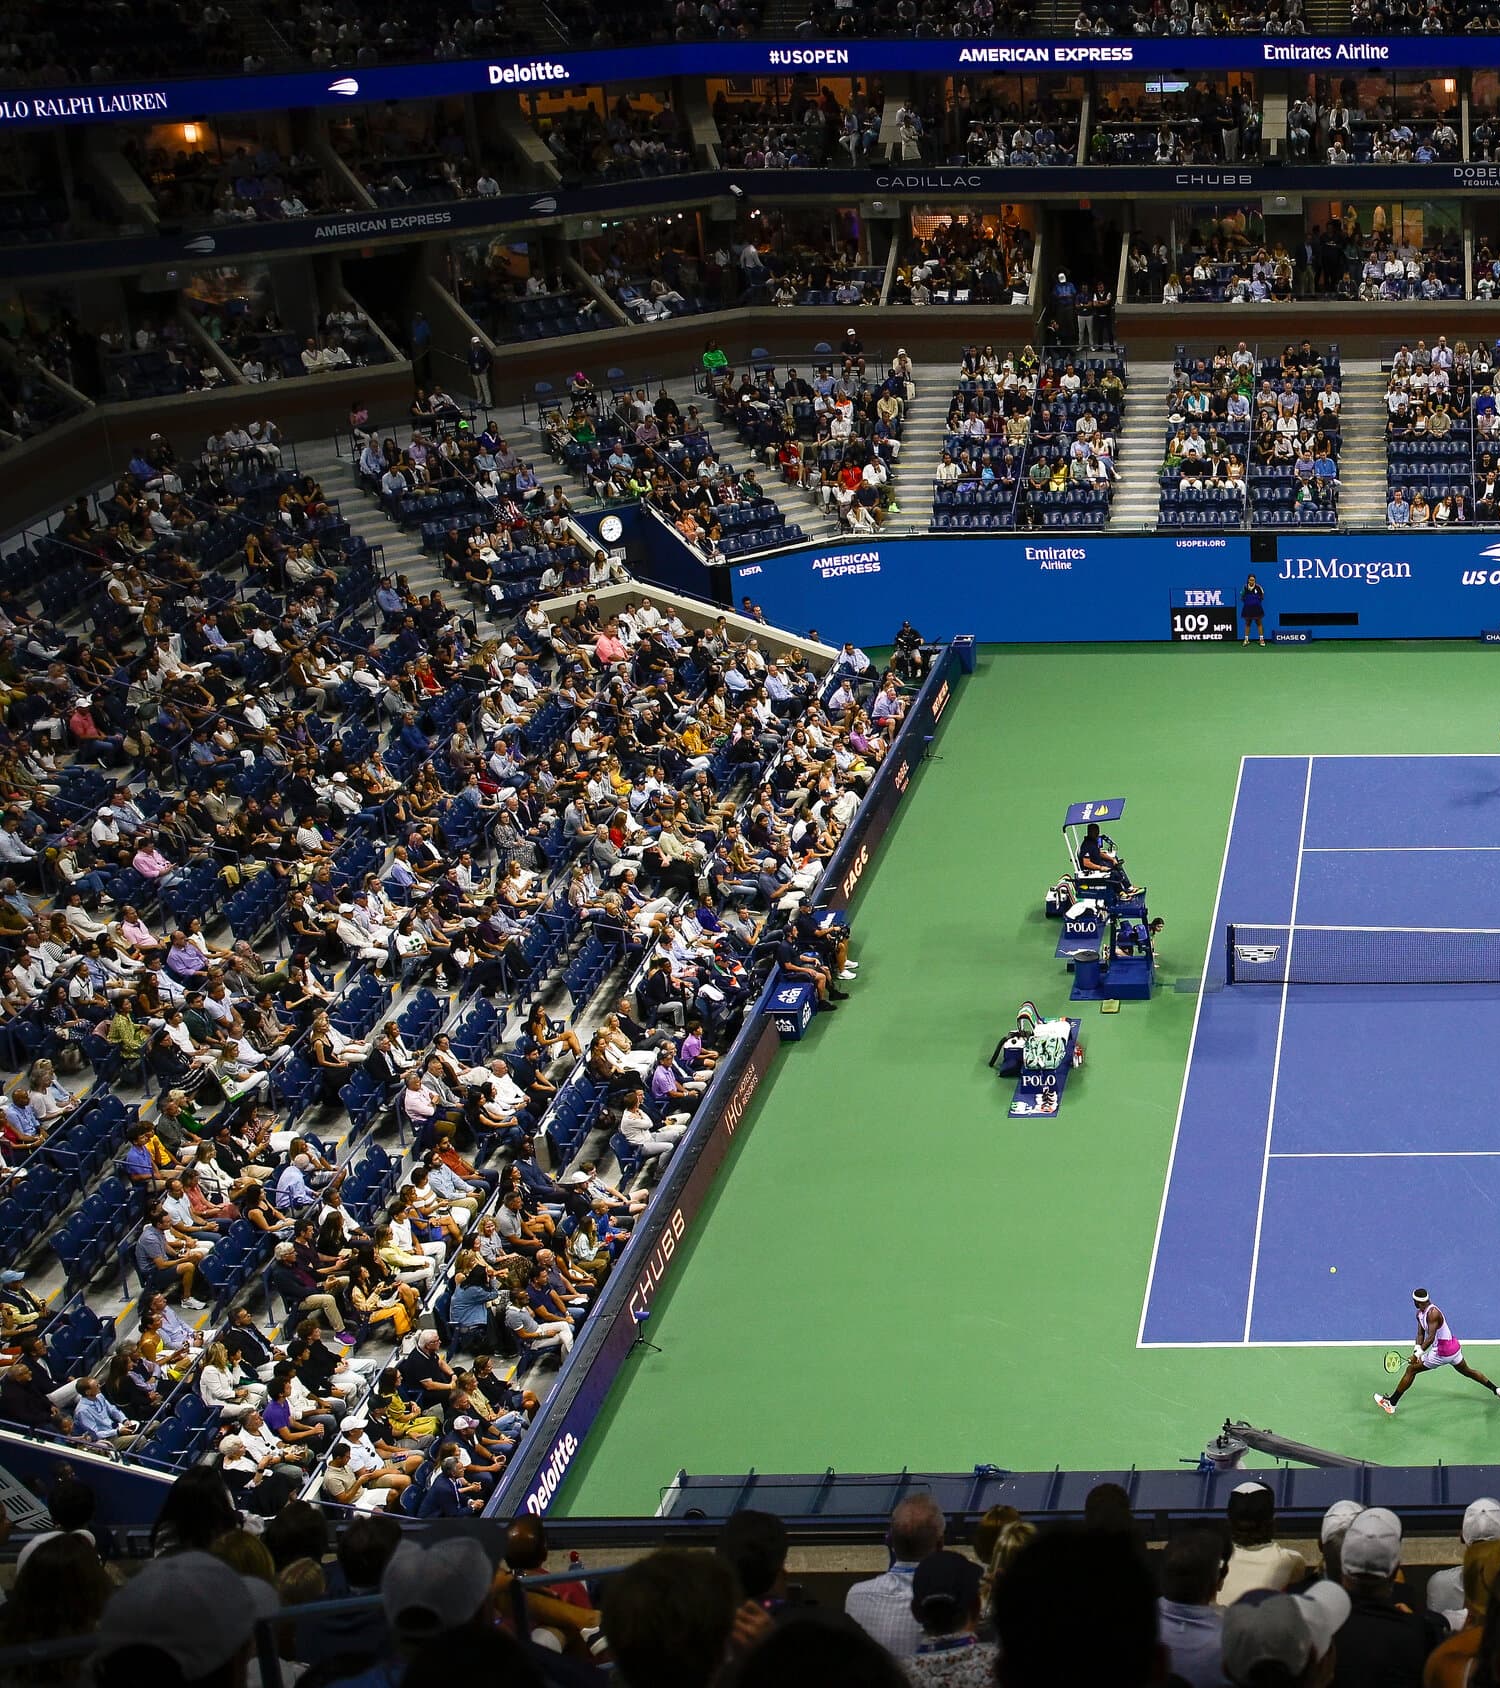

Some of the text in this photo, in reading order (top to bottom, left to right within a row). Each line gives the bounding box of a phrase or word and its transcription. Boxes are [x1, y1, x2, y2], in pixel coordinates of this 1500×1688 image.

[769, 49, 849, 65] #USOPEN
[958, 48, 1133, 62] AMERICAN EXPRESS
[1263, 44, 1389, 60] Emirates Airline
[488, 62, 570, 84] Deloitte.
[0, 92, 168, 119] LO RALPH LAUREN
[876, 176, 982, 187] CADILLAC
[1176, 175, 1252, 185] CHUBB
[314, 212, 452, 238] AMERICAN EXPRESS
[1176, 539, 1226, 548] USOPEN.ORG
[812, 551, 881, 572] AMERICAN
[1025, 546, 1086, 562] Emirates
[739, 565, 763, 577] USTA
[821, 562, 881, 578] EXPRESS
[1040, 559, 1073, 570] Airline
[1278, 558, 1412, 585] J.P.Morgan
[1461, 570, 1487, 586] us
[1185, 590, 1222, 606] IBM
[1173, 614, 1232, 632] 109 MPH
[1276, 633, 1299, 641] CHASE
[1066, 921, 1096, 933] POLO
[1022, 1074, 1057, 1087] POLO
[724, 1093, 743, 1136] IHG
[629, 1208, 685, 1325] CHUBB
[526, 1432, 578, 1517] Deloitte.
